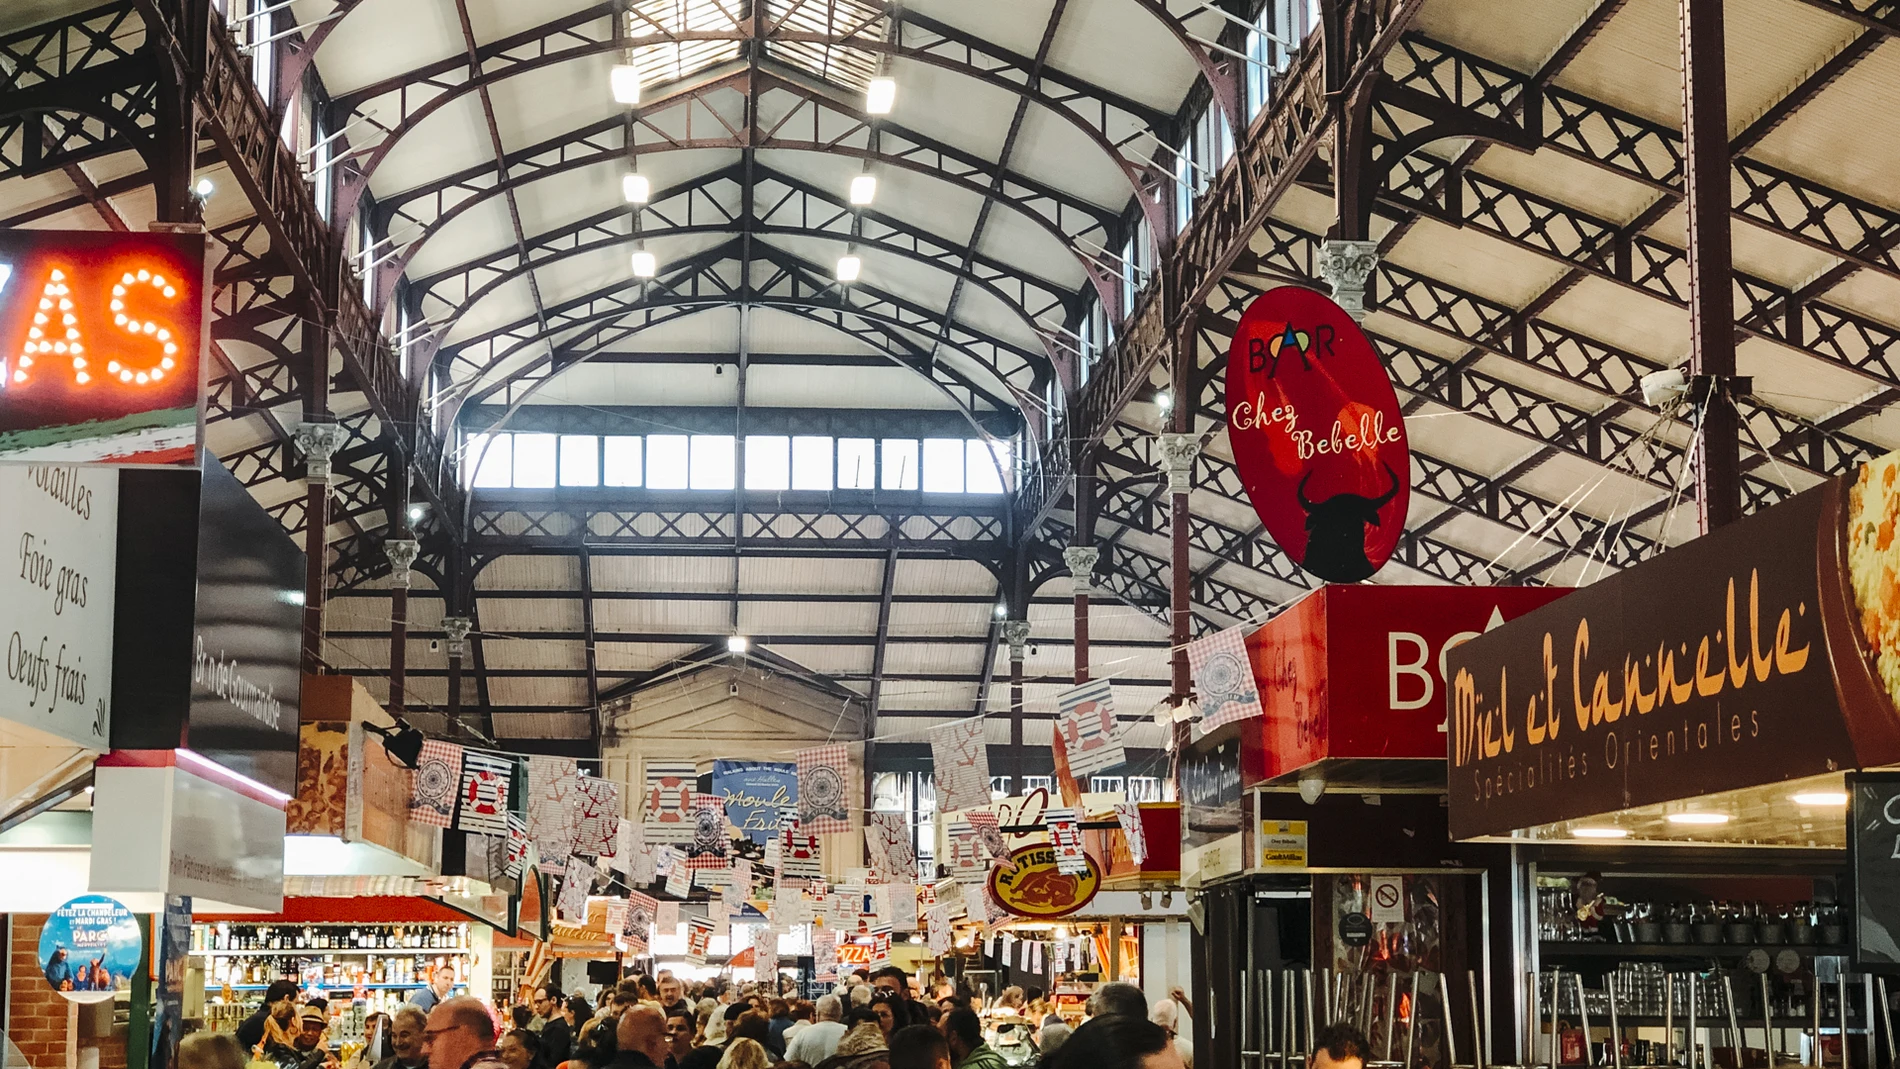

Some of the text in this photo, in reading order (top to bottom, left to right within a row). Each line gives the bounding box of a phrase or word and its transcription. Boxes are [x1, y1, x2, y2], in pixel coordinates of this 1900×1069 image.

[0, 264, 178, 386] AS
[1232, 391, 1299, 434] Chez
[1292, 411, 1402, 459] Bebelle
[19, 531, 89, 616] Foie gras
[7, 630, 88, 714] Oeufs frais
[1526, 632, 1561, 747] et
[1573, 569, 1812, 732] Cannelle
[1473, 701, 1760, 808] Spécialités Orientales
[723, 785, 798, 809] Moule
[75, 917, 95, 925] MARDI
[96, 917, 112, 925] GRAS
[78, 909, 86, 917] LA
[836, 946, 872, 963] PIZZA
